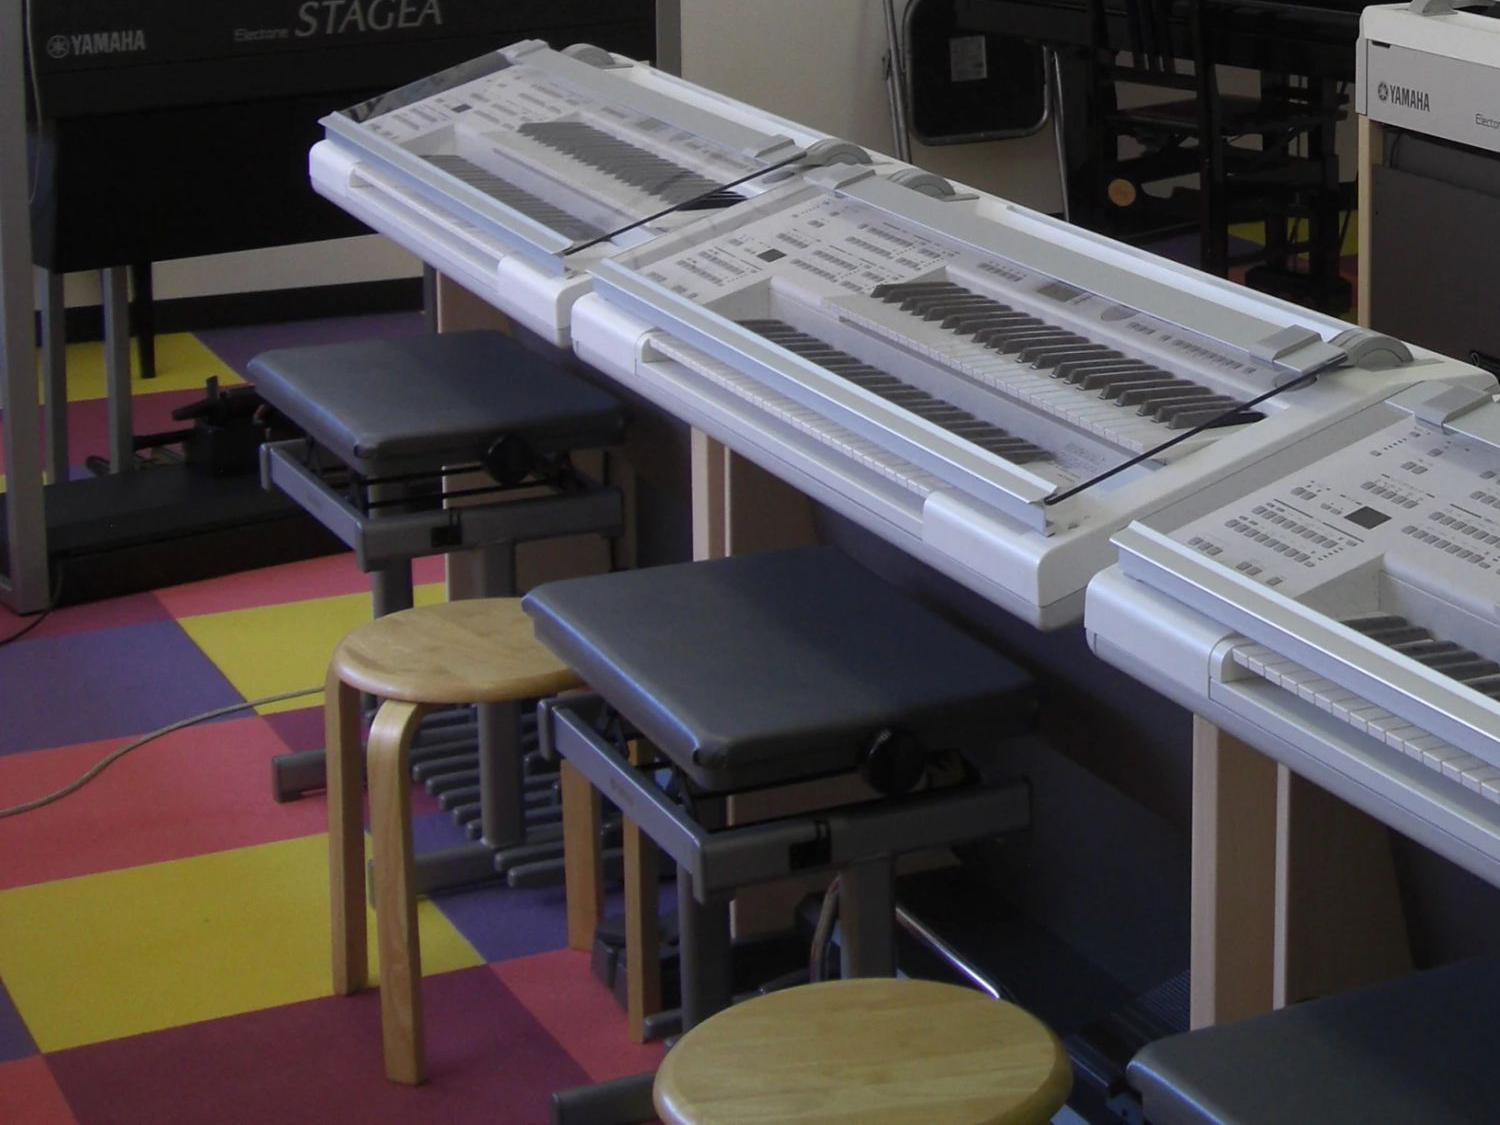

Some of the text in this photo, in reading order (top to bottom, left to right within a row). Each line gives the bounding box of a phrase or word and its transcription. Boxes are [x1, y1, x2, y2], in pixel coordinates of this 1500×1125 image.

[71, 30, 147, 56] YAMAHA
[234, 28, 289, 42] Electone
[1389, 84, 1431, 113] YAMAHA
